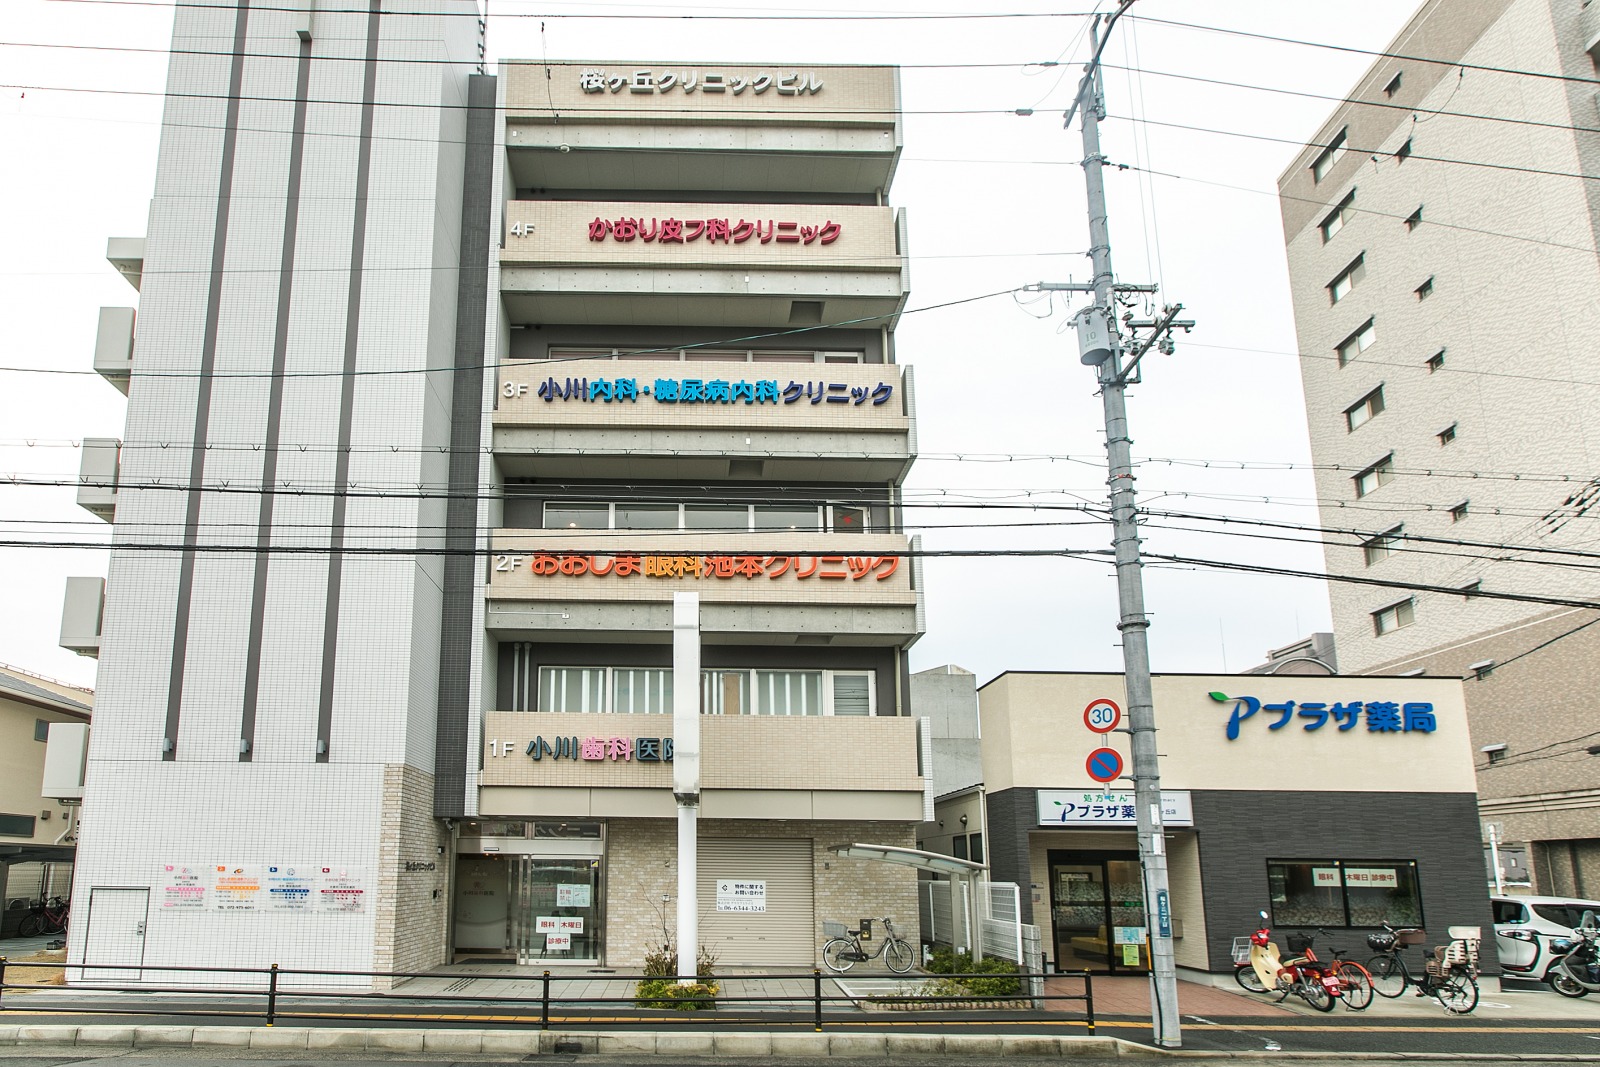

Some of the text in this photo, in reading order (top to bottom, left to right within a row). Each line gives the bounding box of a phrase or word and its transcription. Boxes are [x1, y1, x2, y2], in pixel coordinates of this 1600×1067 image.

[510, 221, 535, 237] 4F
[588, 216, 842, 244] かおり皮フ科クリニック
[503, 381, 528, 398] 3F
[538, 376, 893, 406] 小川内科・糖尿病内科クリニック
[496, 554, 522, 572] 2F
[1091, 707, 1113, 725] 30
[1263, 700, 1437, 733] プラザ薬局
[489, 738, 515, 758] 1F
[1083, 794, 1128, 803] 処方せん
[1077, 804, 1136, 819] プラザ薬
[1345, 873, 1368, 881] 木曜日
